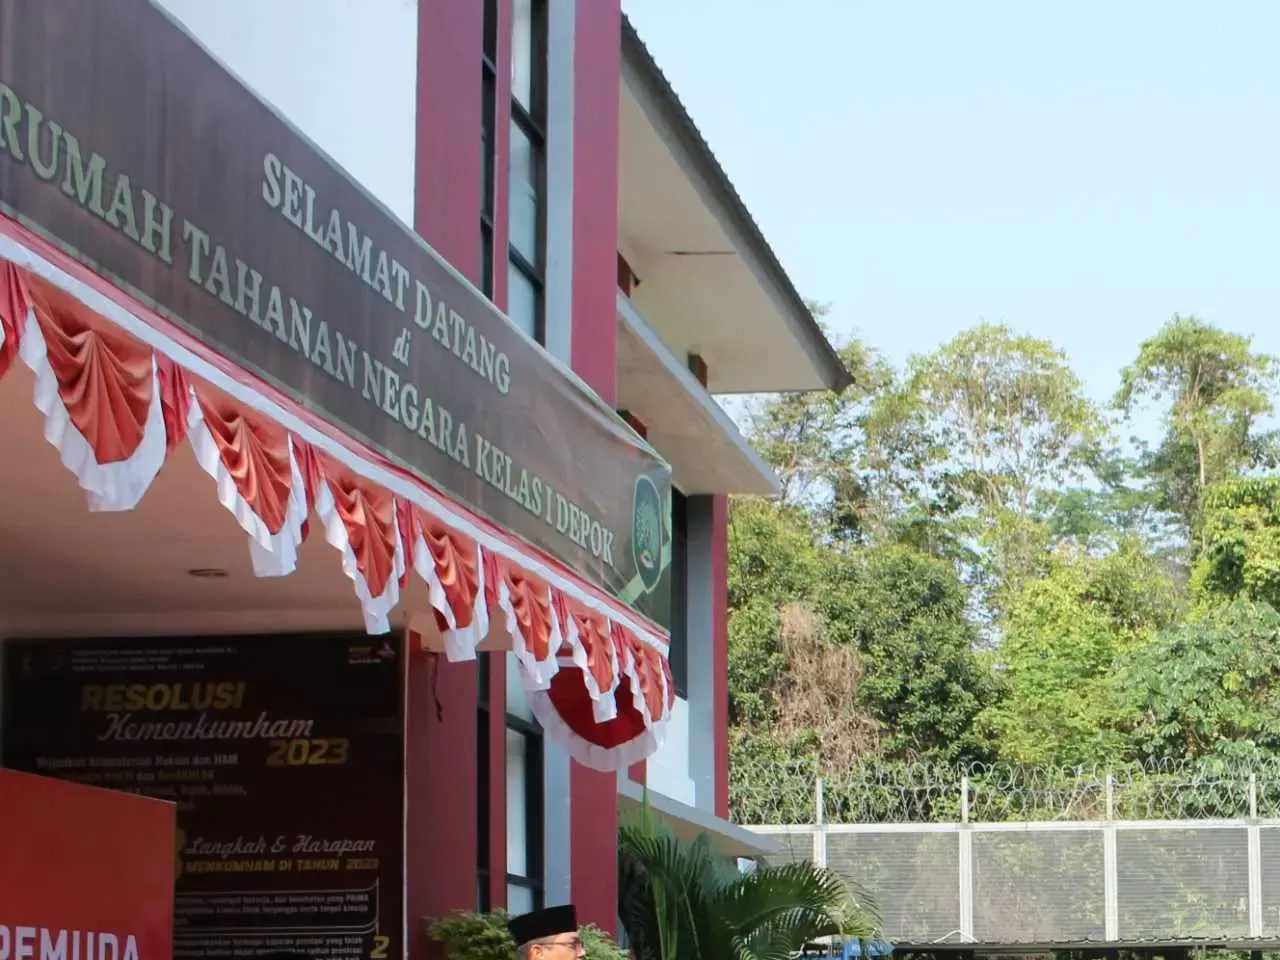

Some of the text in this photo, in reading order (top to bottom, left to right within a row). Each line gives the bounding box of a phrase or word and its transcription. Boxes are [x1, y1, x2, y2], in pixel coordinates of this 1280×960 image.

[262, 152, 511, 394] SELAMAT DATANG
[0, 83, 616, 566] RUMAH TAHANAN NEGARA KELAS I DEPOK
[392, 327, 412, 367] di
[81, 681, 246, 713] RESOLUSI
[97, 710, 314, 742] Kemenkumham
[265, 737, 351, 768] 2023
[185, 833, 376, 859] Langkah & Harapan
[279, 859, 292, 872] DI
[296, 858, 339, 871] TAHUN
[370, 936, 390, 959] 2
